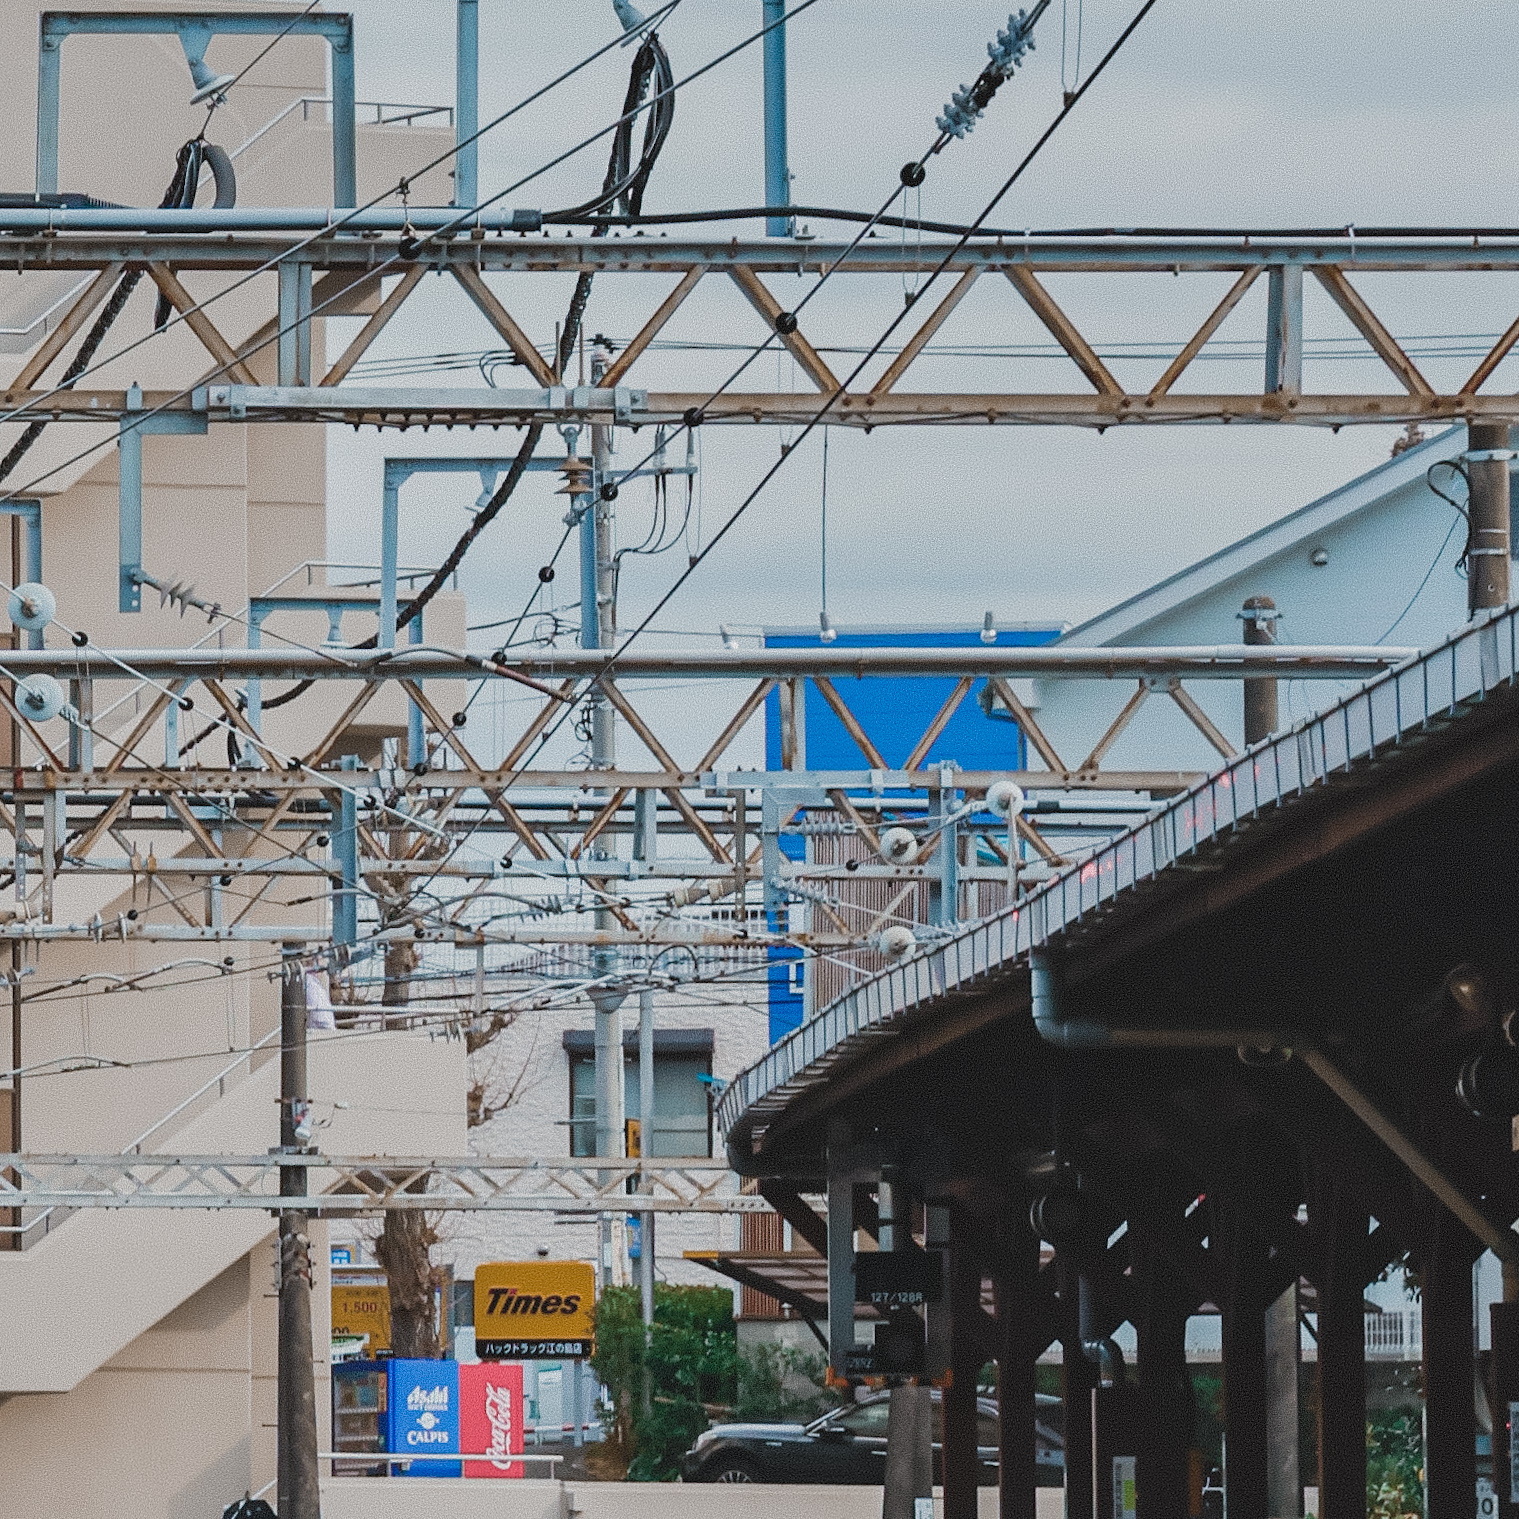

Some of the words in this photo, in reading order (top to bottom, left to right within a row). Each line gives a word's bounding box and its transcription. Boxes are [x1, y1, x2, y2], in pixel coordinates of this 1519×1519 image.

[486, 1287, 581, 1315] Times
[407, 1385, 449, 1404] Asahi
[406, 1430, 449, 1446] CALPIS
